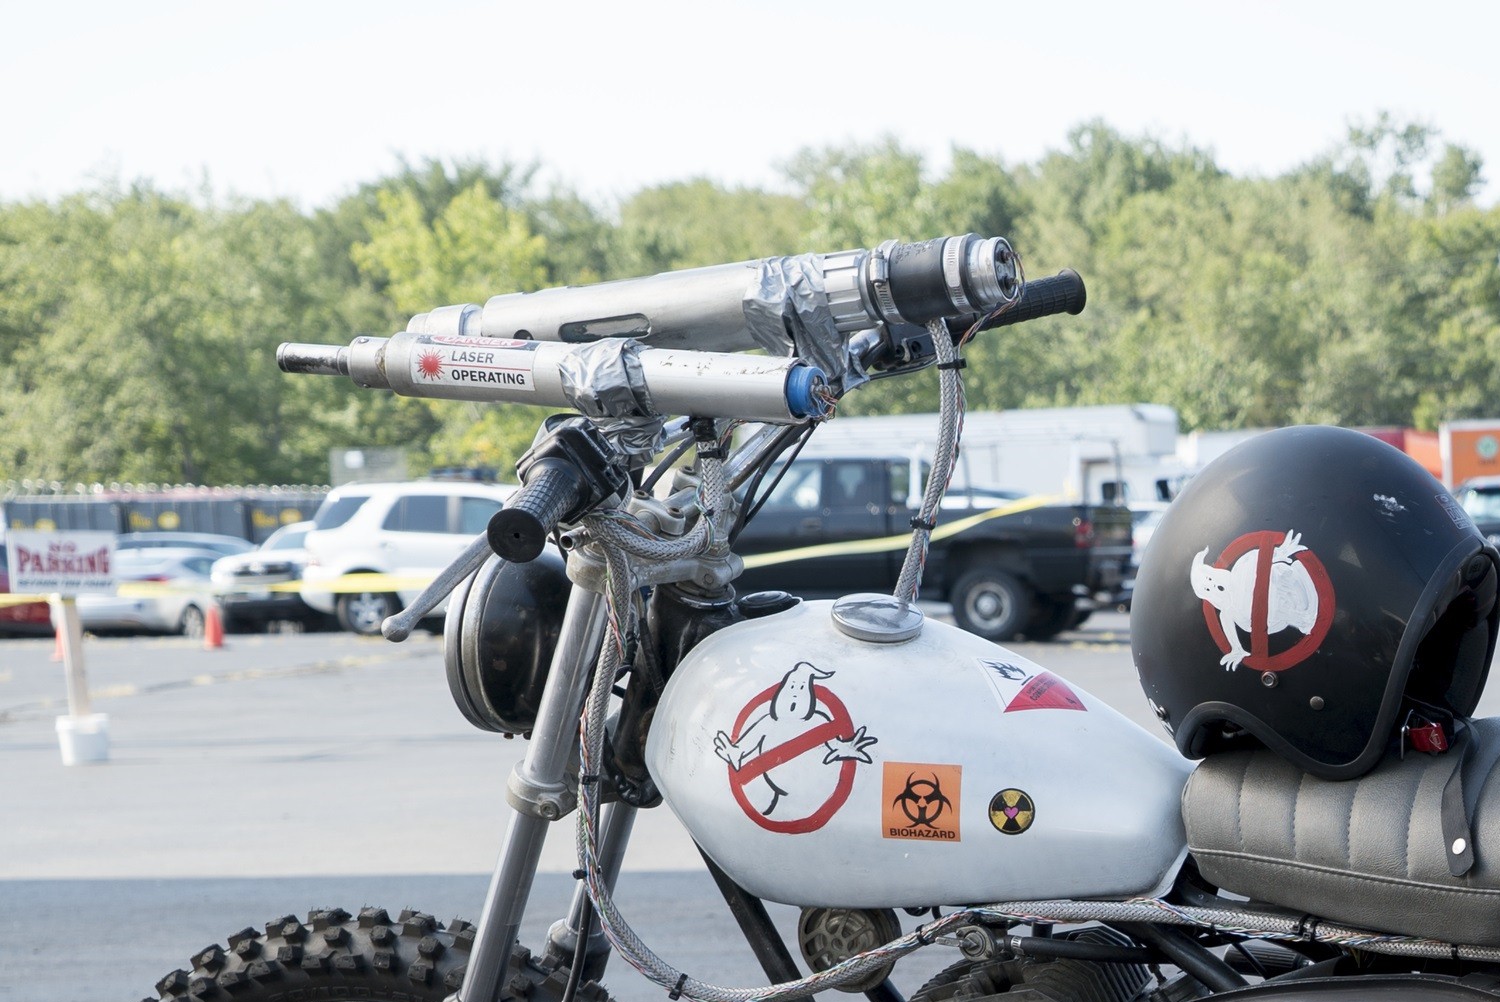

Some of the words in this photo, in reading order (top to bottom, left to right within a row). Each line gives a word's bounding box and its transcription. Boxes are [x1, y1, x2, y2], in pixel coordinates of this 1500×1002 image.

[451, 350, 495, 364] LASER
[451, 369, 526, 386] OPERATING
[17, 545, 109, 573] PARKING
[889, 828, 956, 839] BIOHAZARD
